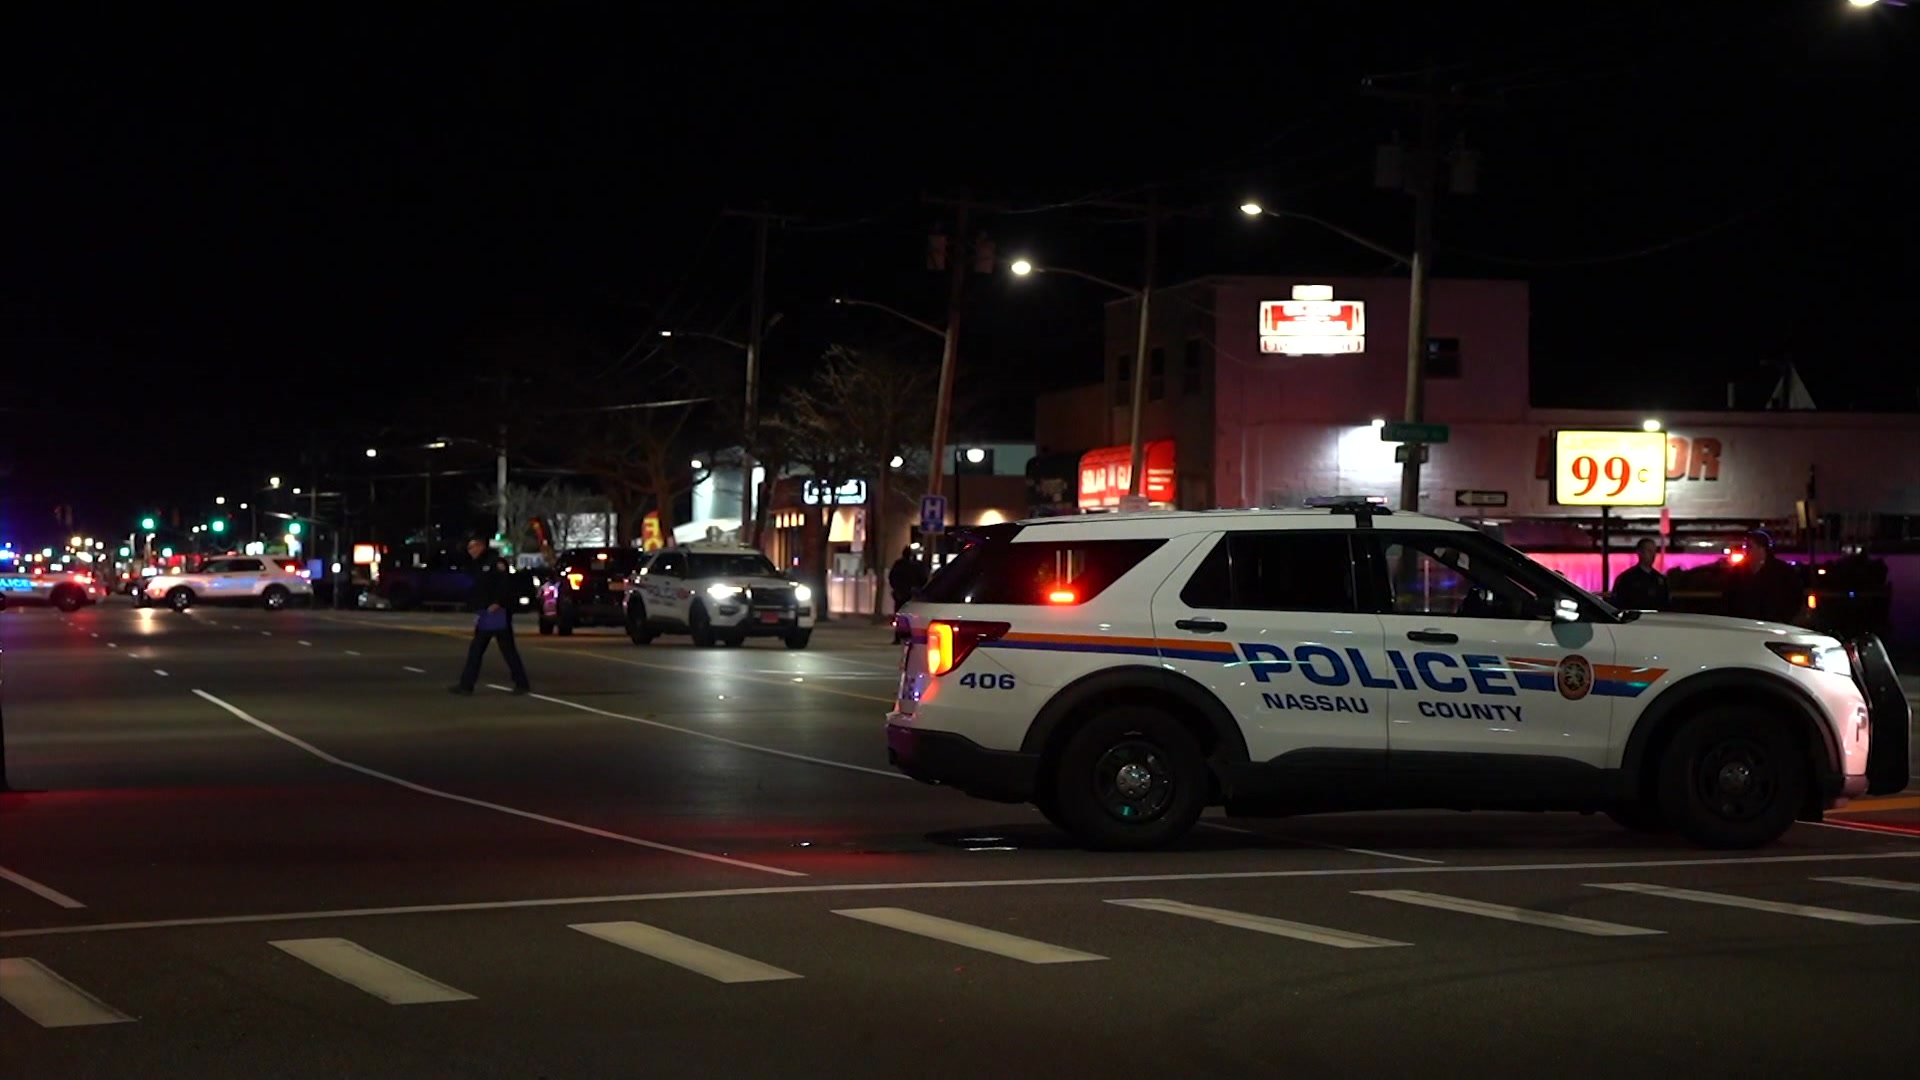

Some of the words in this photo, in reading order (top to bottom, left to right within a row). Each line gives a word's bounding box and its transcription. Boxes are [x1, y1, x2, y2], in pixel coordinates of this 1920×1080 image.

[924, 498, 942, 520] H
[960, 672, 1015, 690] 406
[1238, 642, 1517, 696] POLICE
[1262, 692, 1368, 714] NASSAU
[1418, 701, 1522, 722] COUNTY
